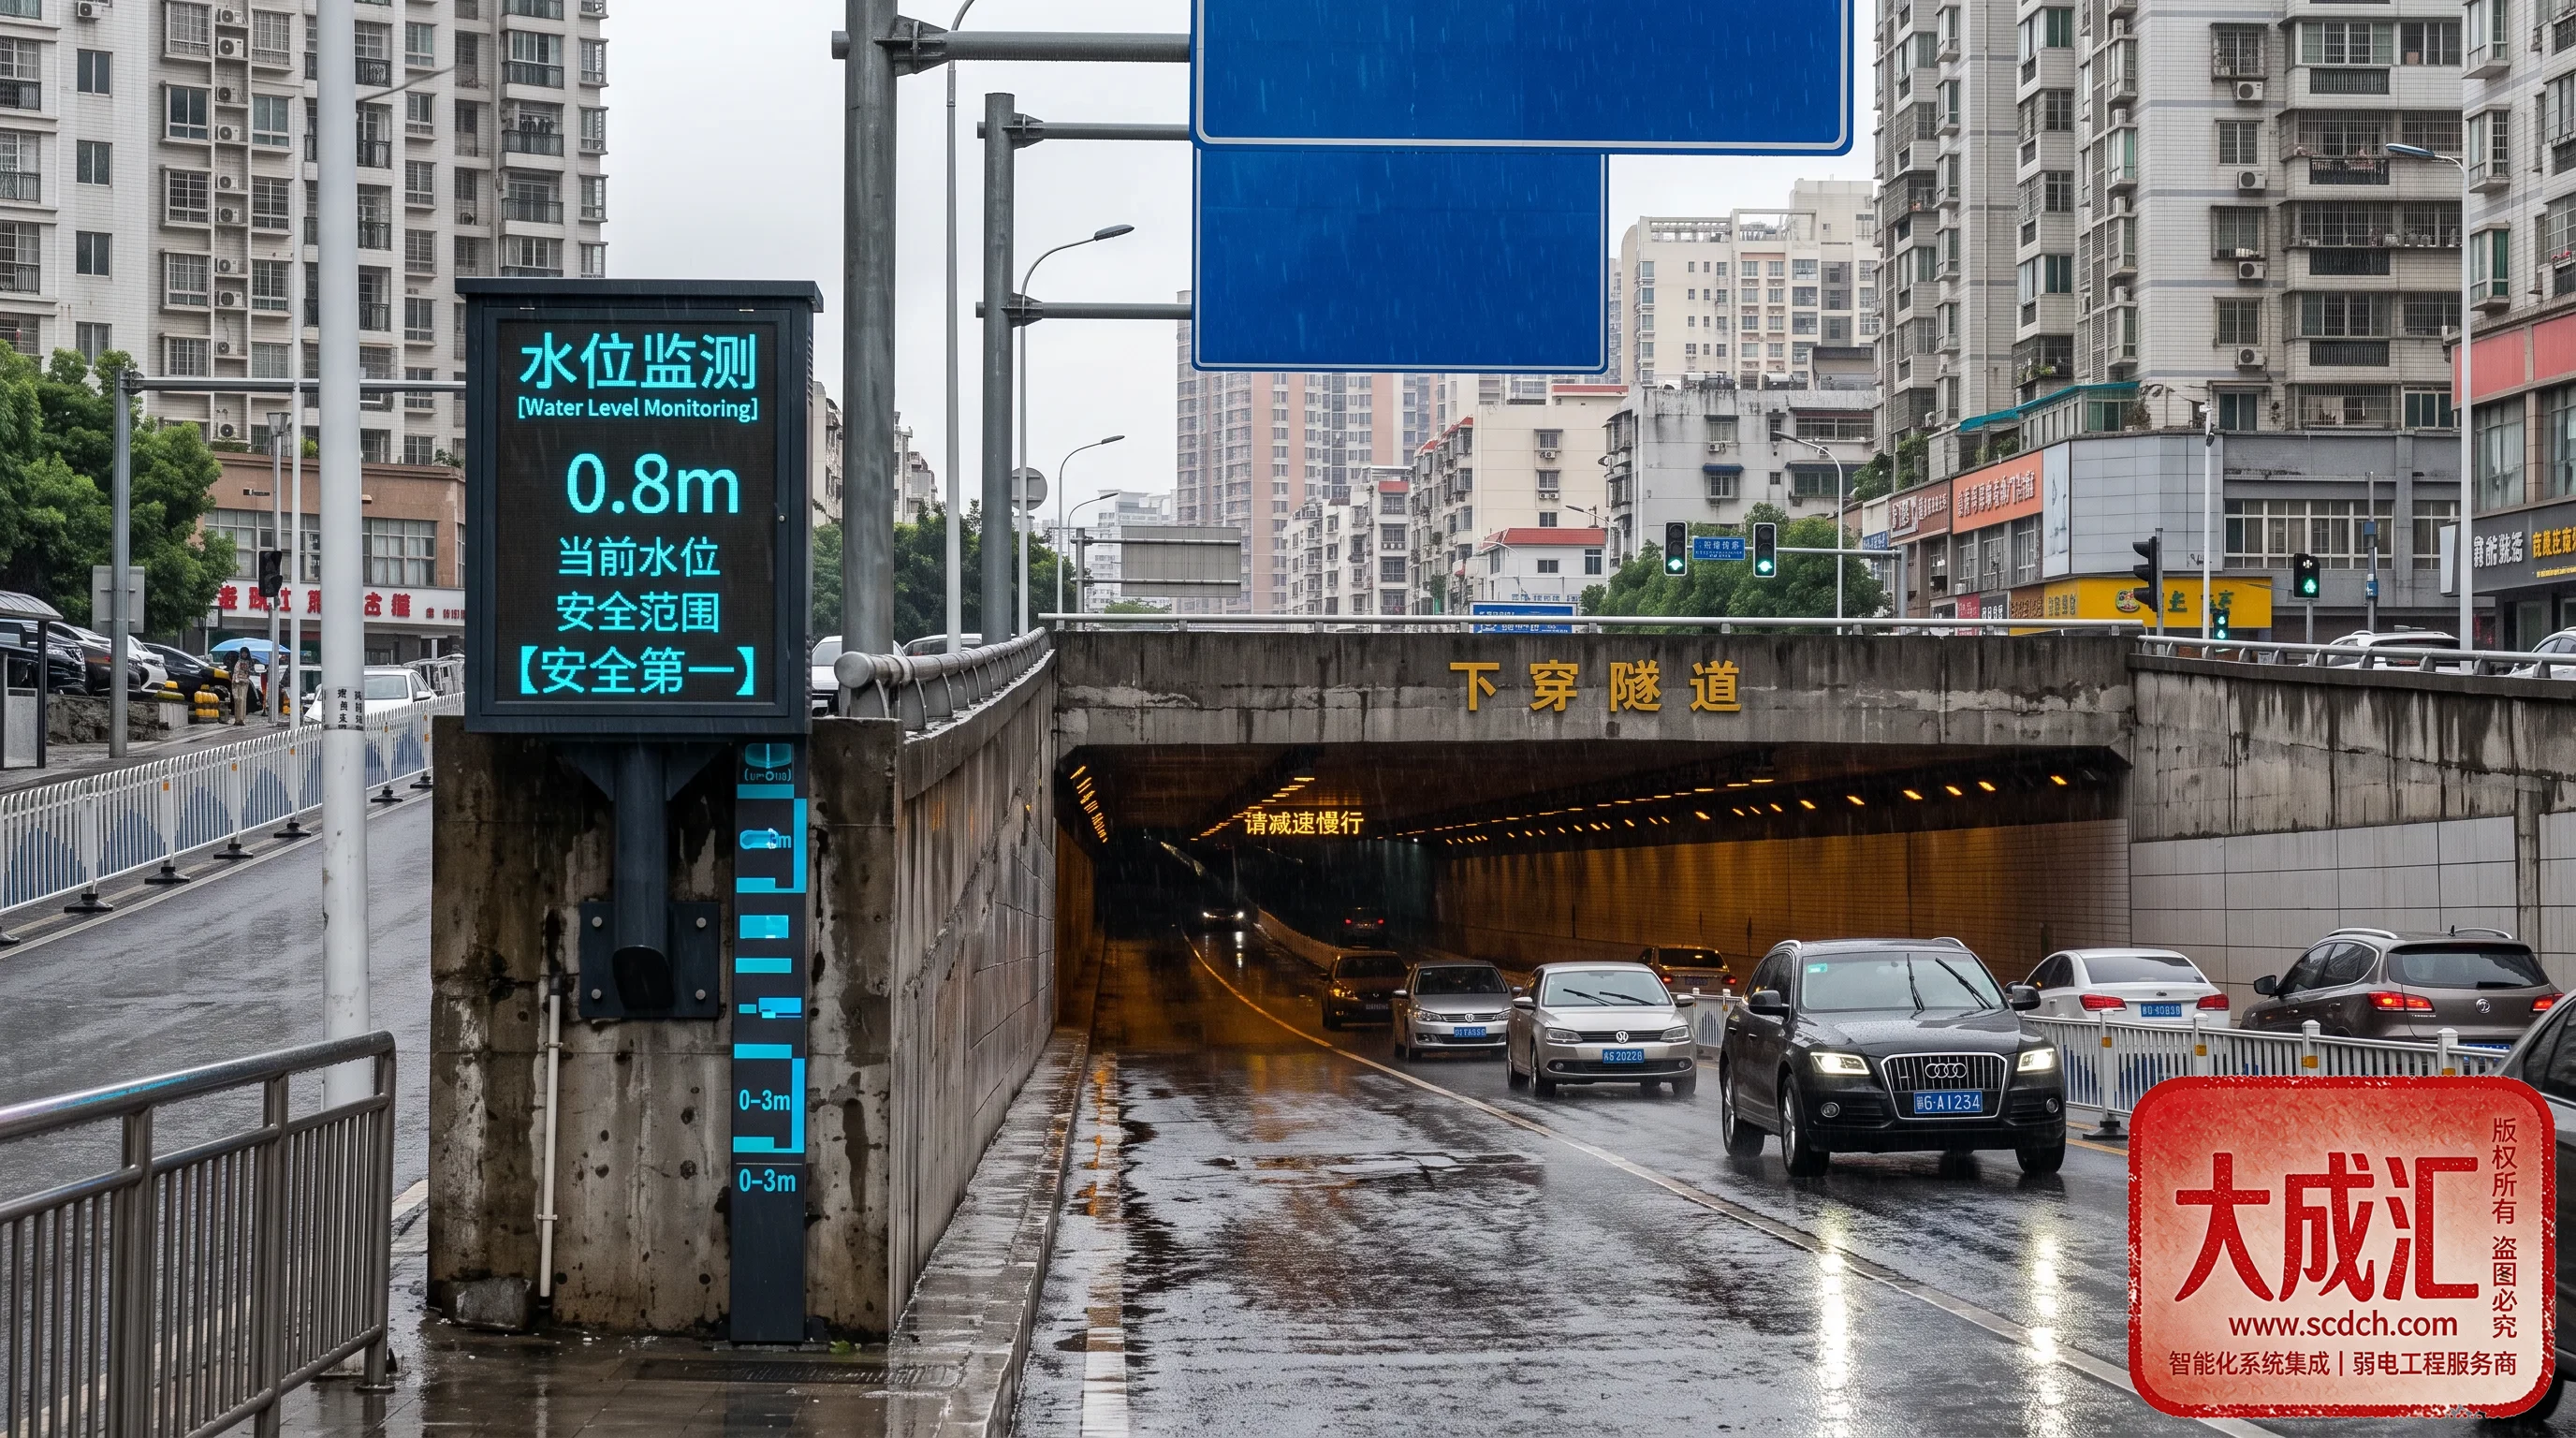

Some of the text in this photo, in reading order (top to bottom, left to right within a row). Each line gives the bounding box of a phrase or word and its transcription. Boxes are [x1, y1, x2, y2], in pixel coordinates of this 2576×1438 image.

[520, 331, 756, 389] 水位监测
[518, 396, 758, 423] [Water Level Monitoring]
[566, 452, 739, 515] 0.8m
[558, 536, 721, 578] 当前水位
[556, 590, 720, 634] 安全范围
[520, 645, 755, 697] 【安全第一】
[1449, 659, 1742, 712] 下穿隧道
[1243, 810, 1366, 835] 请减速慢行
[739, 1089, 791, 1111] 0-3m
[739, 1168, 797, 1192] 0-3m
